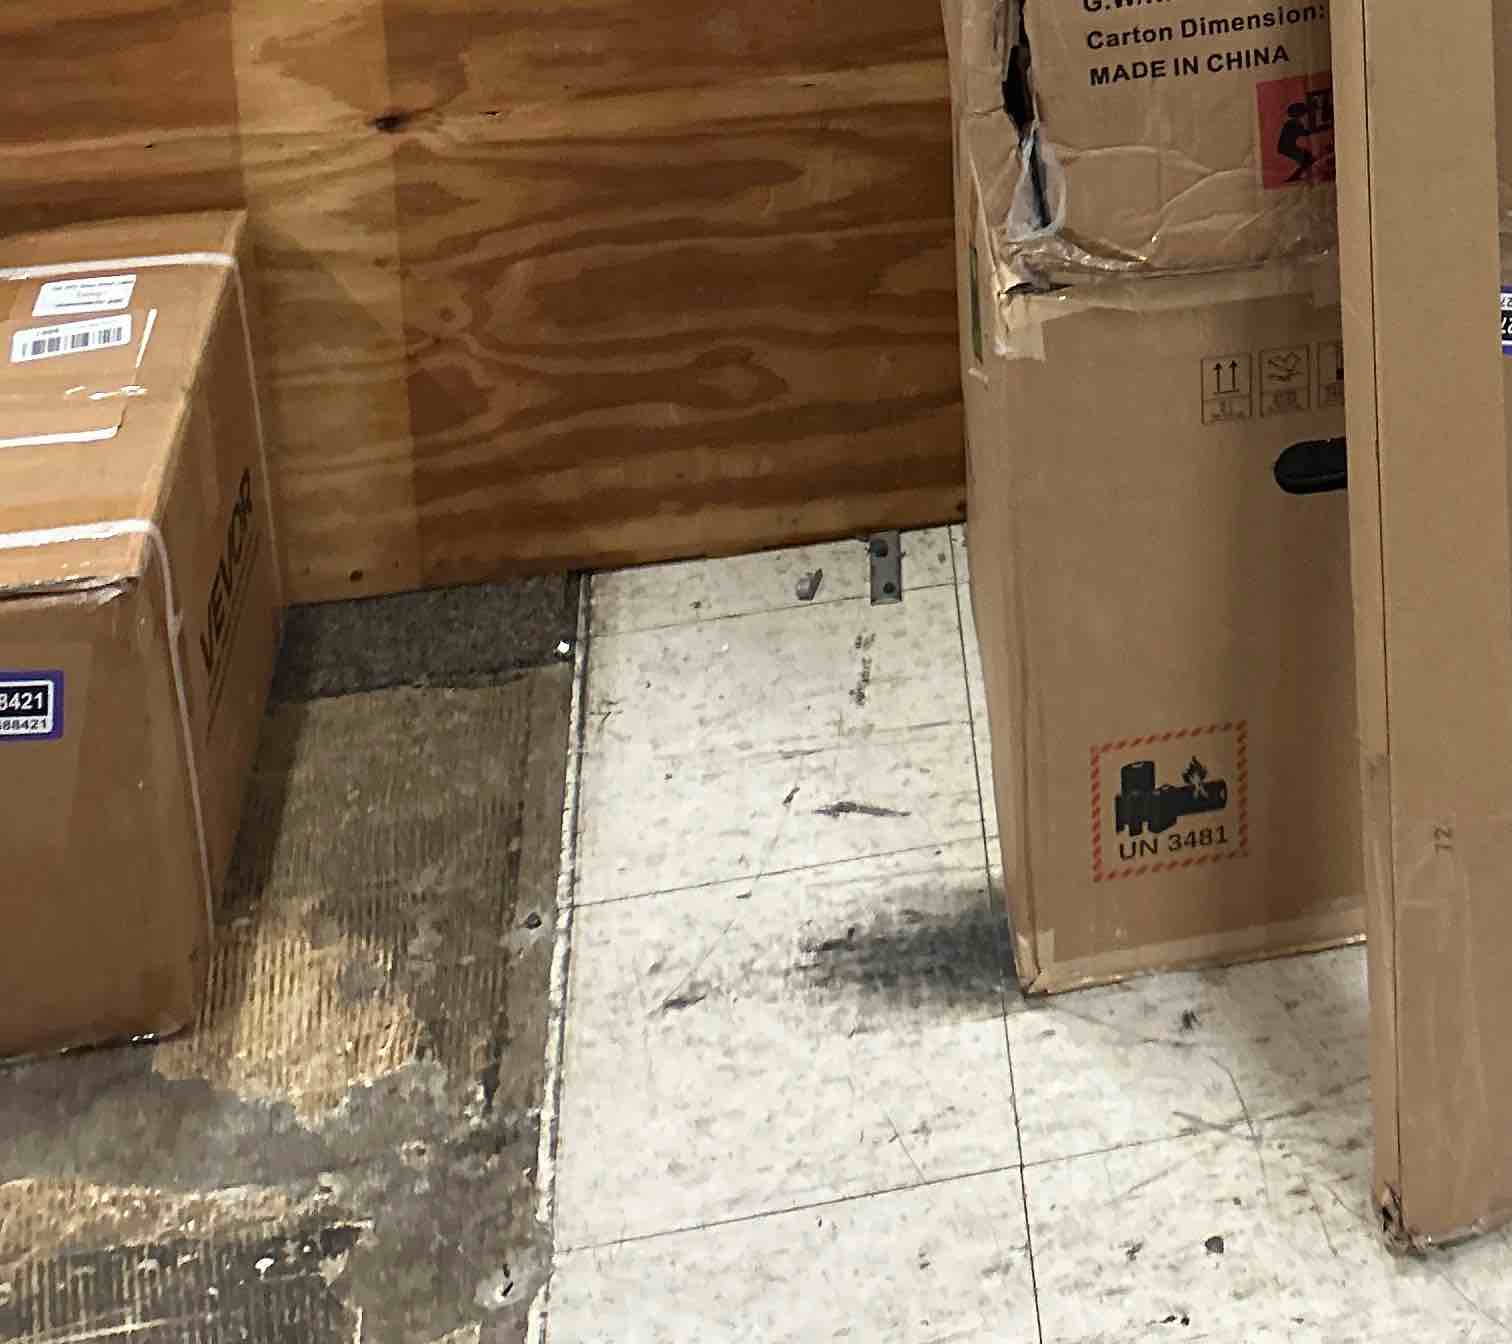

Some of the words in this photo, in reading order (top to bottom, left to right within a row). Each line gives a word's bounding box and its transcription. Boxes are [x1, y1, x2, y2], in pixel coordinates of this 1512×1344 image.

[1087, 26, 1172, 49] Carton
[1181, 4, 1325, 39] Dimension:
[1090, 60, 1166, 86] MADE
[1174, 56, 1199, 76] IN
[1207, 45, 1289, 73] CHINA
[0, 719, 48, 732] 88421
[1118, 836, 1159, 861] UN
[1167, 824, 1229, 854] 3481
